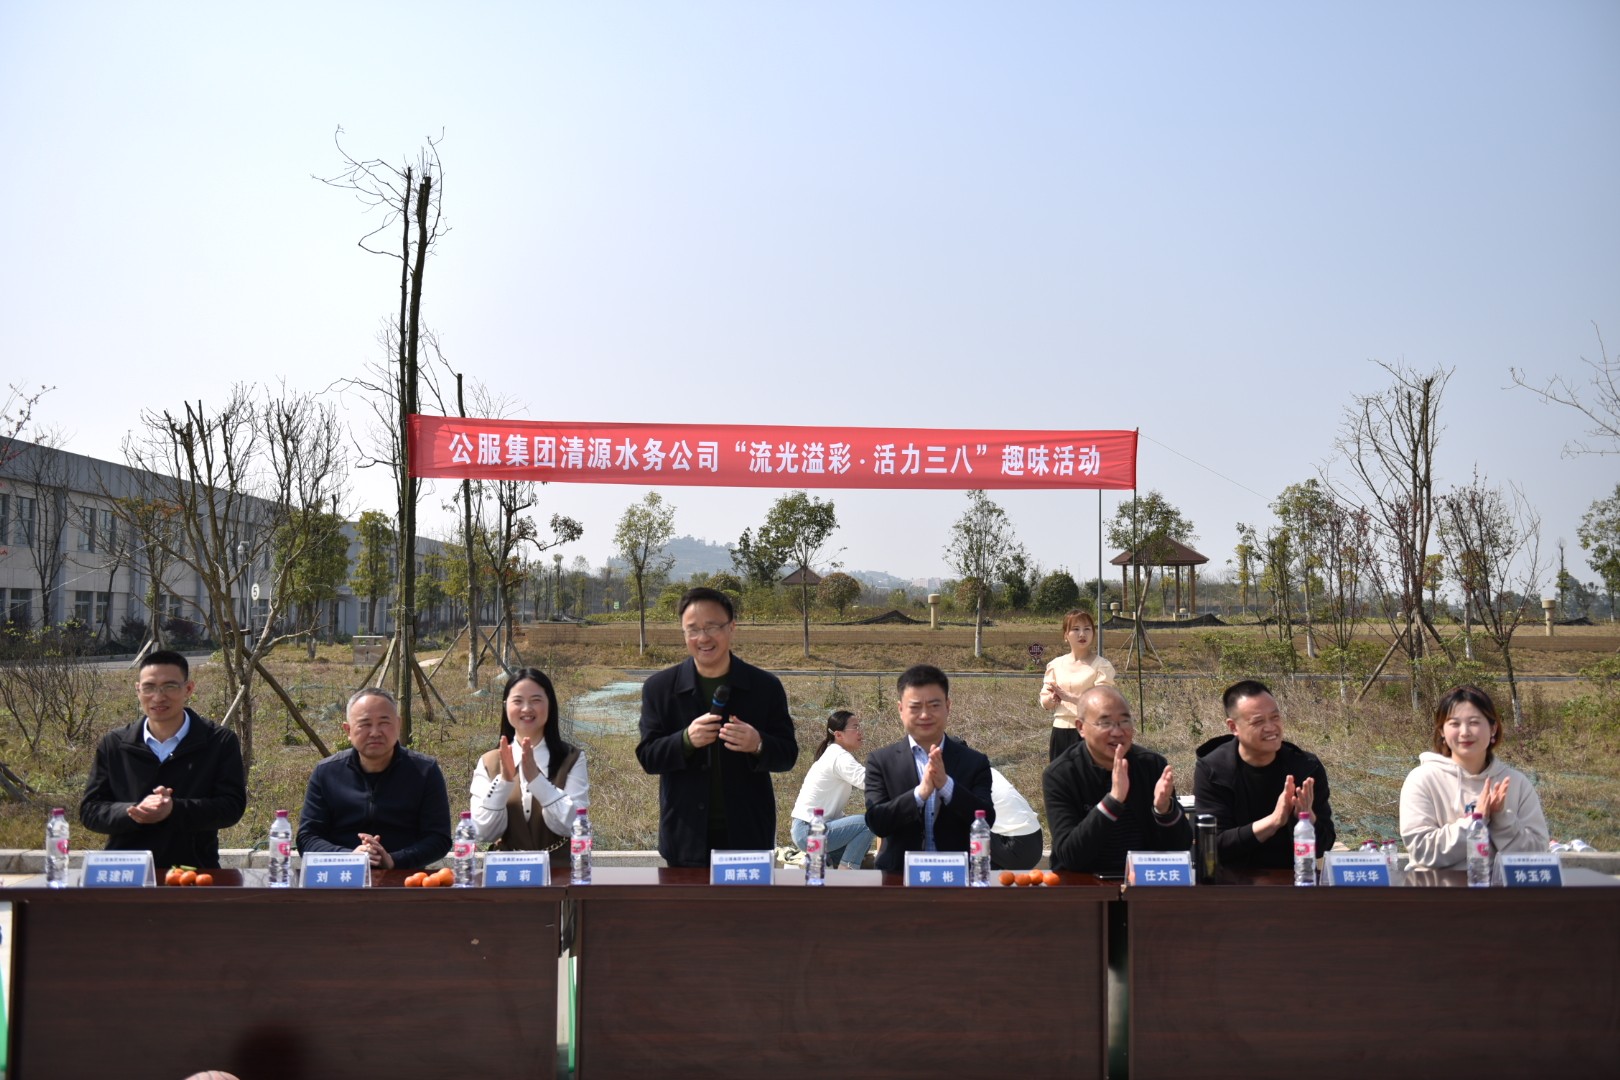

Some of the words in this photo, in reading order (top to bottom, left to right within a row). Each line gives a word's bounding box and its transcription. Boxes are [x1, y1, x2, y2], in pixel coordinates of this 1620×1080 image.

[1144, 870, 1181, 882] 任大庆
[1343, 870, 1379, 882] 陈兴华
